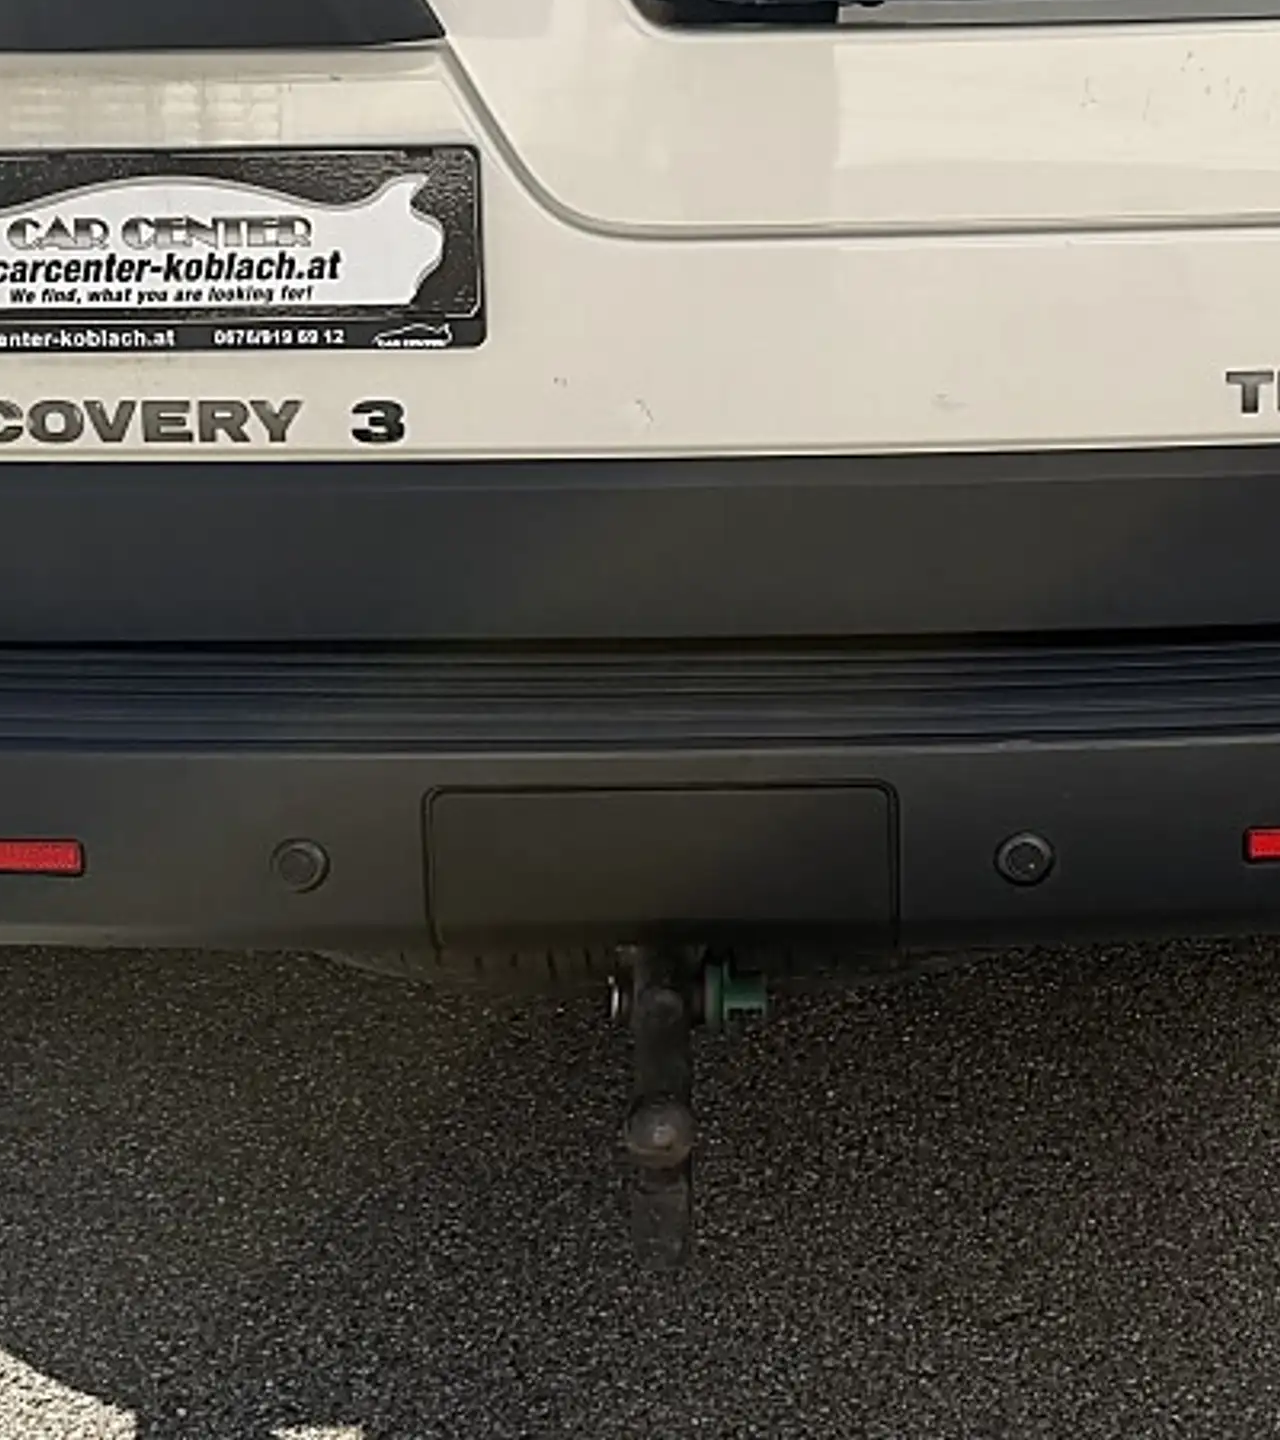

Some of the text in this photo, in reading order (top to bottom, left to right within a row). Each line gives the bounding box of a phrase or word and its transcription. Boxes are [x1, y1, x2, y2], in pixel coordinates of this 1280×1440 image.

[5, 215, 313, 251] CAR CENTER
[9, 287, 36, 304] We
[41, 287, 82, 305] find,
[87, 287, 132, 303] what
[137, 289, 168, 305] you
[173, 288, 203, 302] are
[207, 285, 274, 305] looking
[323, 328, 345, 344] 12
[350, 399, 406, 444] 3
